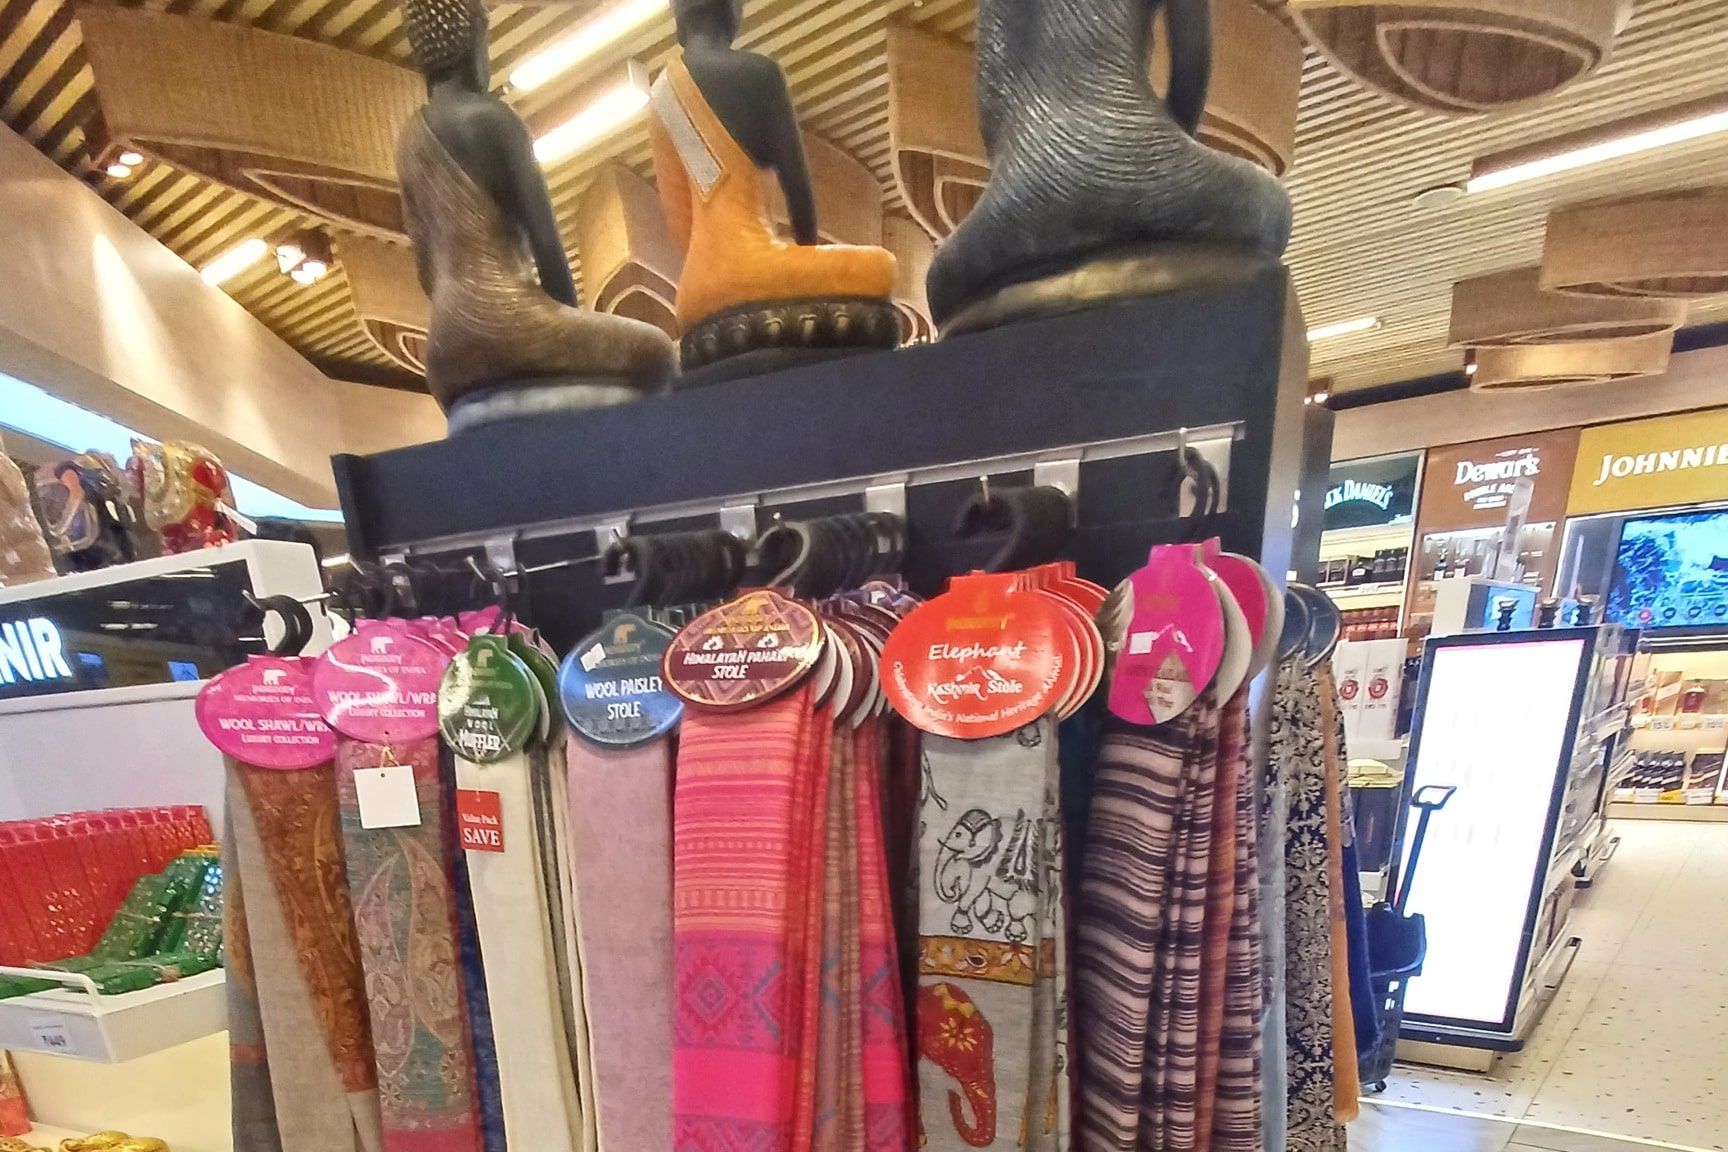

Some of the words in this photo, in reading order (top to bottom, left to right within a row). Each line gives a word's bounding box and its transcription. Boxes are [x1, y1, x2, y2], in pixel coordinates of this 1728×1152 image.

[1454, 453, 1540, 485] Dewar's
[1592, 443, 1728, 486] JOHNNIE
[1324, 486, 1343, 510] CK
[1343, 480, 1394, 510] DANIEL'S
[0, 617, 73, 684] NIR
[683, 650, 746, 665] HIMALAYAN
[928, 641, 1027, 663] Elephant
[711, 665, 749, 679] STOLE
[585, 681, 619, 699] WOOL
[621, 676, 663, 696] PAISLEY
[927, 682, 988, 705] Kashmir
[988, 679, 1023, 694] Stole
[607, 701, 642, 720] STOLE
[218, 718, 257, 731] WOOL
[258, 719, 333, 733] SHAWL/WRA
[459, 728, 501, 751] MUFFLER
[463, 828, 501, 846] SAVE
